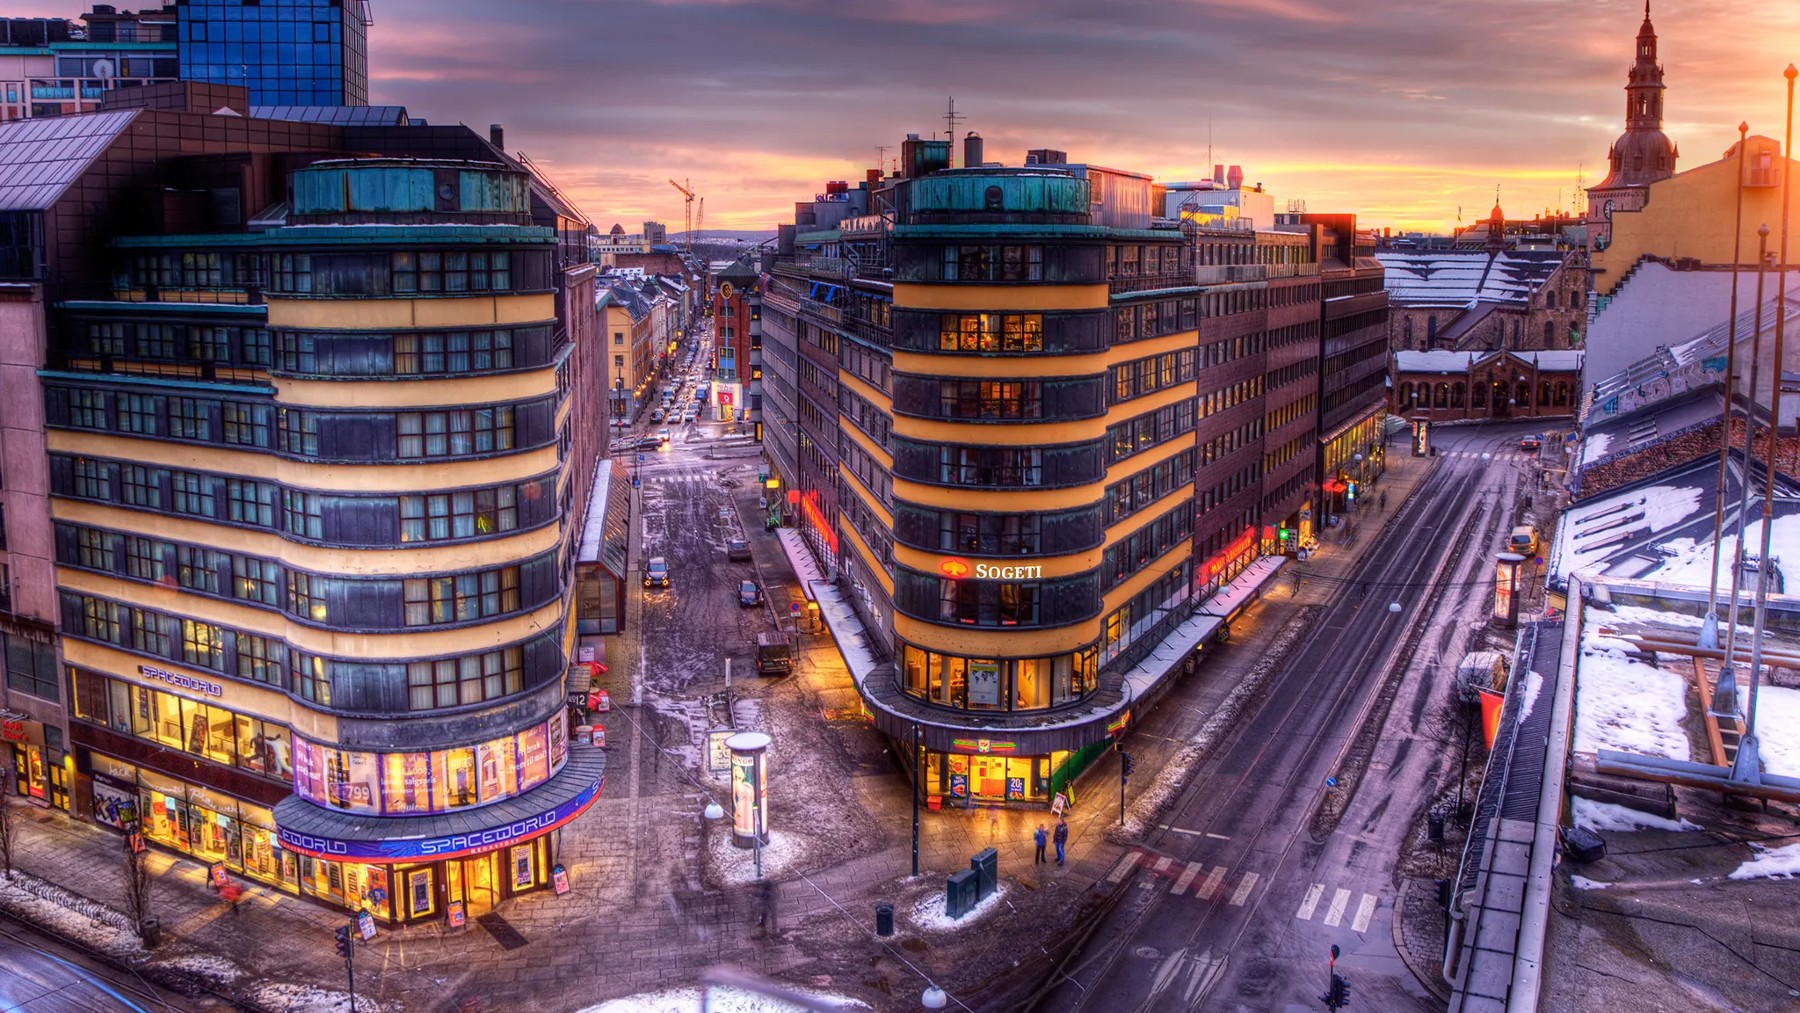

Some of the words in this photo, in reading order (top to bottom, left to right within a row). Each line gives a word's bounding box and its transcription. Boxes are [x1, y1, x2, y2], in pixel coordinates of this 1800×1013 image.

[976, 563, 1042, 580] SOGETI
[142, 666, 222, 697] SPACEWORLD
[344, 784, 370, 800] 799
[421, 810, 556, 854] SPACEWORLD
